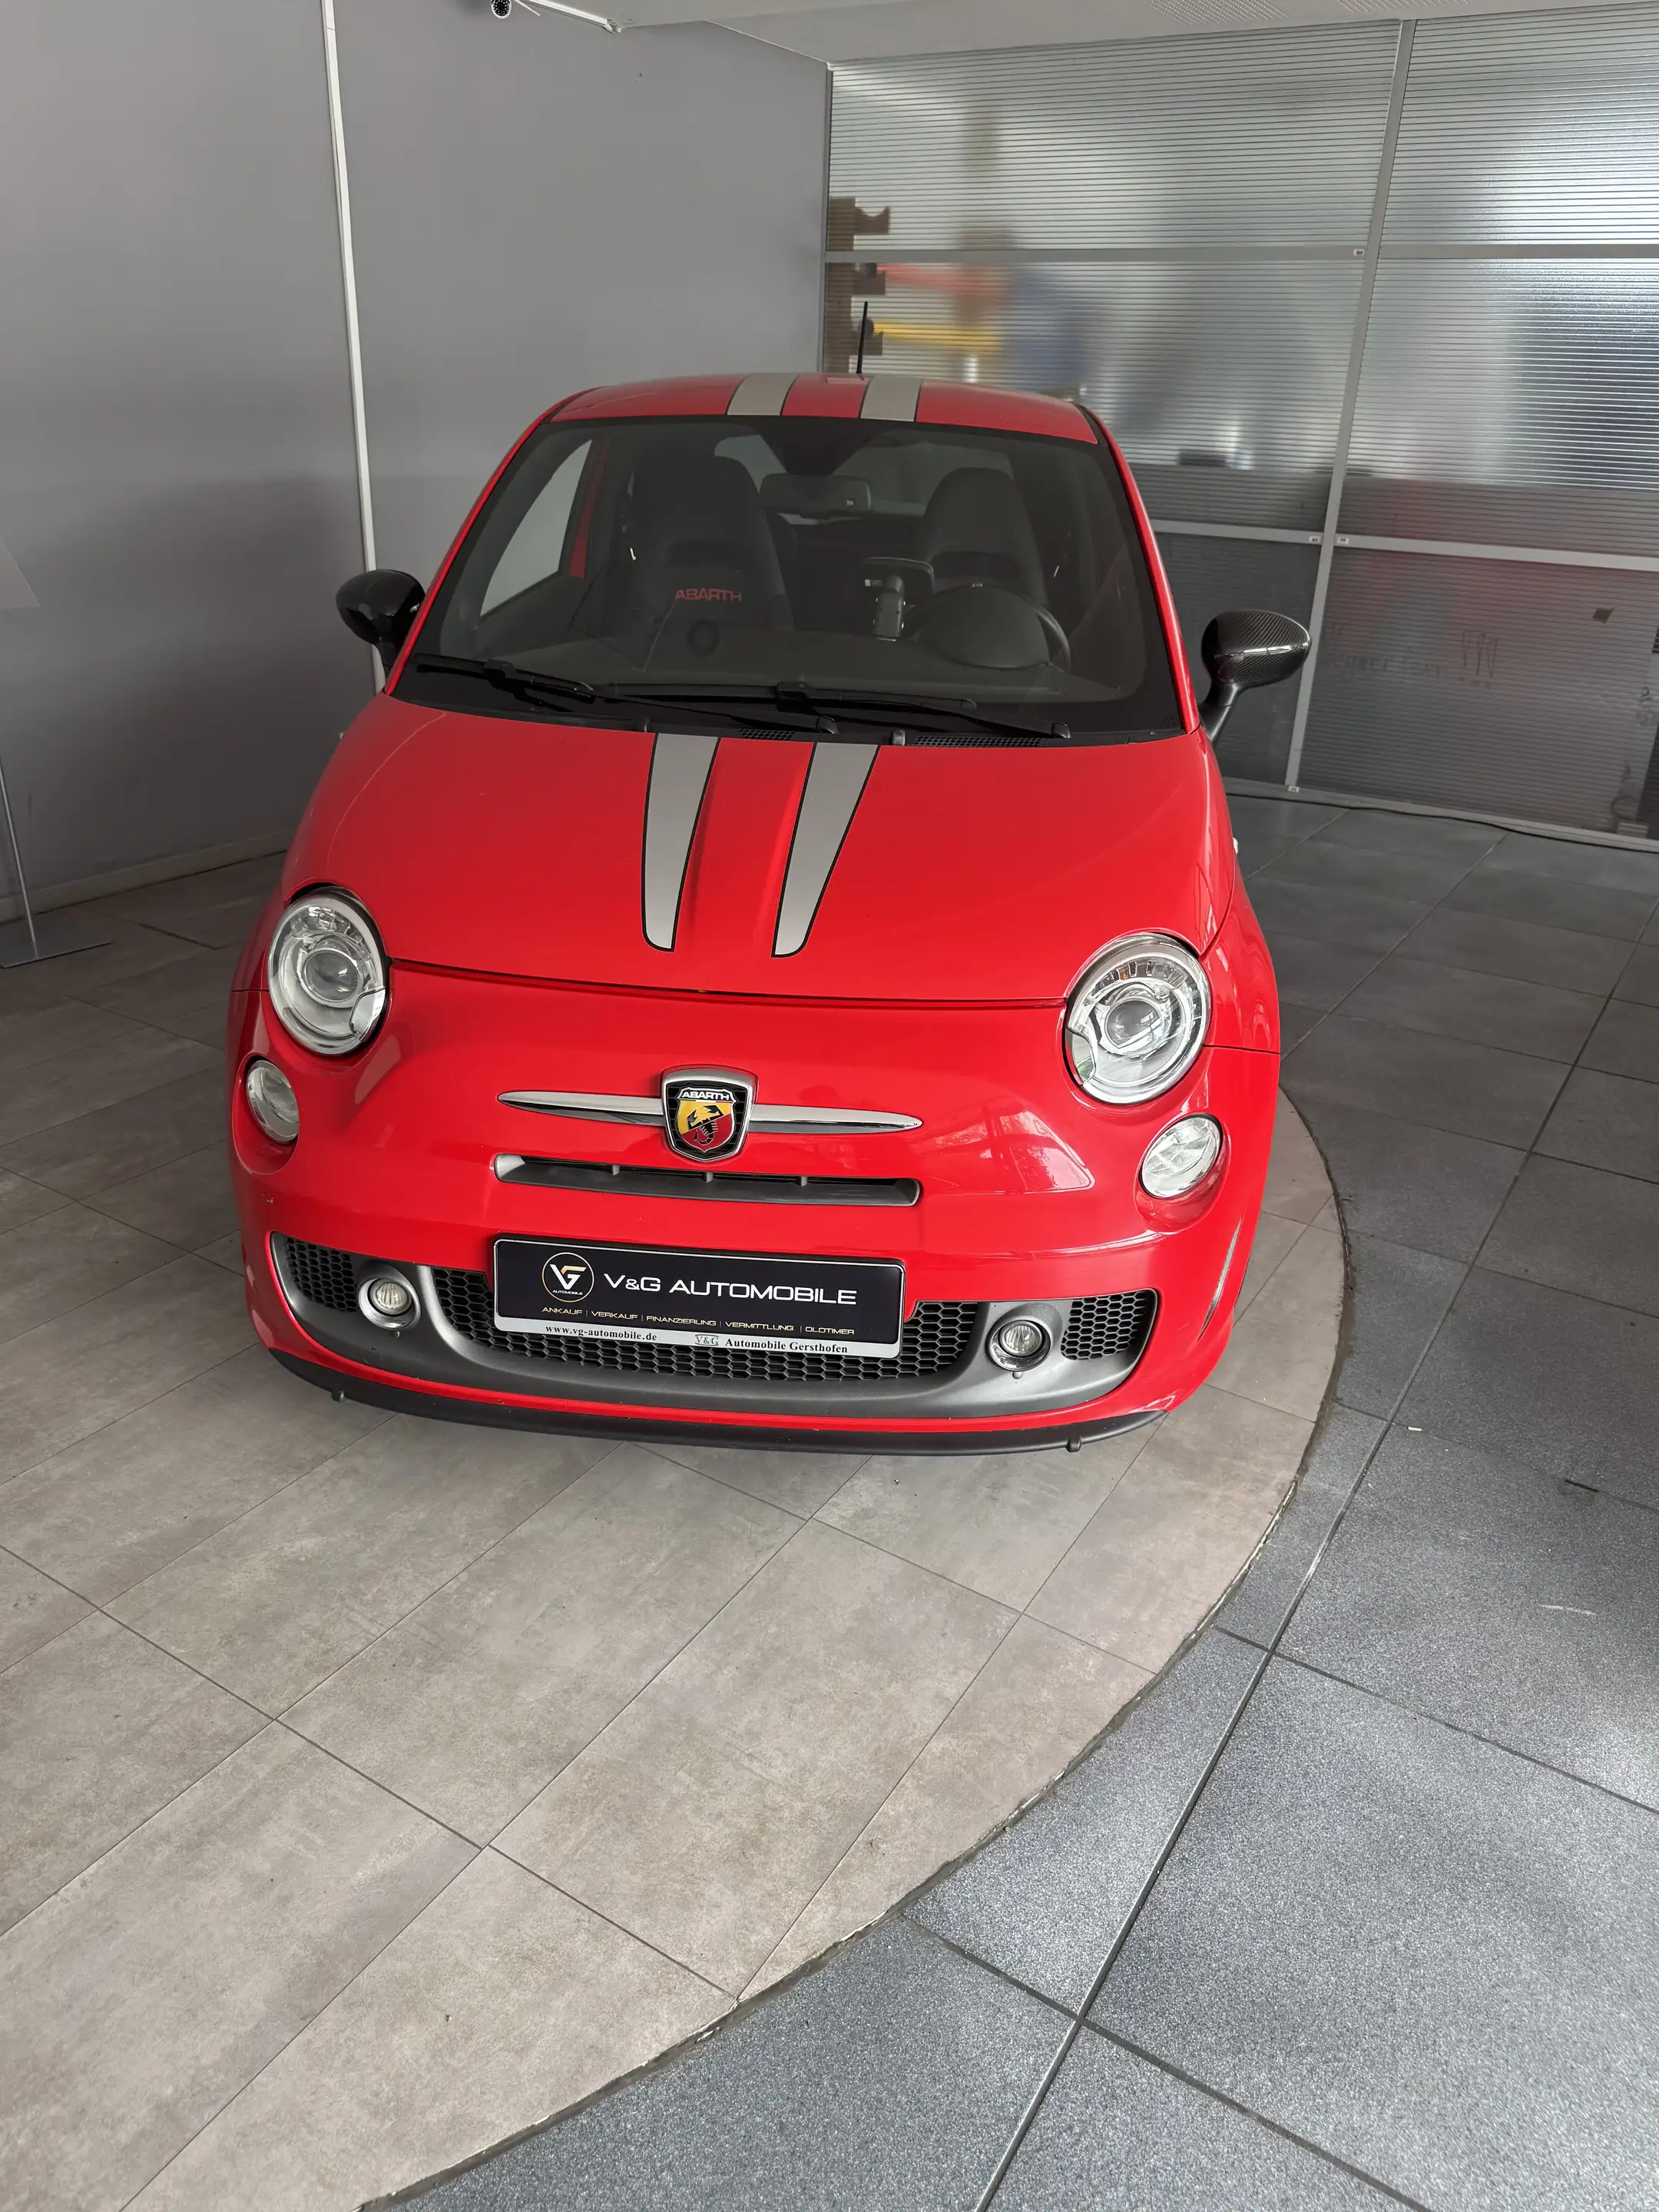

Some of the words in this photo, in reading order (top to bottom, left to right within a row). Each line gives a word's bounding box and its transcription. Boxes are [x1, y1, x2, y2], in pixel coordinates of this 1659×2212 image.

[675, 588, 742, 601] ABARTH
[681, 1091, 730, 1101] ABARTH
[603, 1273, 661, 1293] V&G
[668, 1279, 857, 1305] AUTOMOBILE
[541, 1306, 583, 1316] ANKAUF
[591, 1310, 638, 1320] VERKAUF
[646, 1315, 717, 1326] FINANZIERUNG
[725, 1321, 794, 1332] VERMITTLUNG
[805, 1326, 855, 1335] OLDTIMER
[545, 1325, 657, 1342] www.vg-automobile.de
[694, 1334, 720, 1346] V&G
[724, 1338, 786, 1350] Automobile
[789, 1343, 849, 1353] Gersthofen
